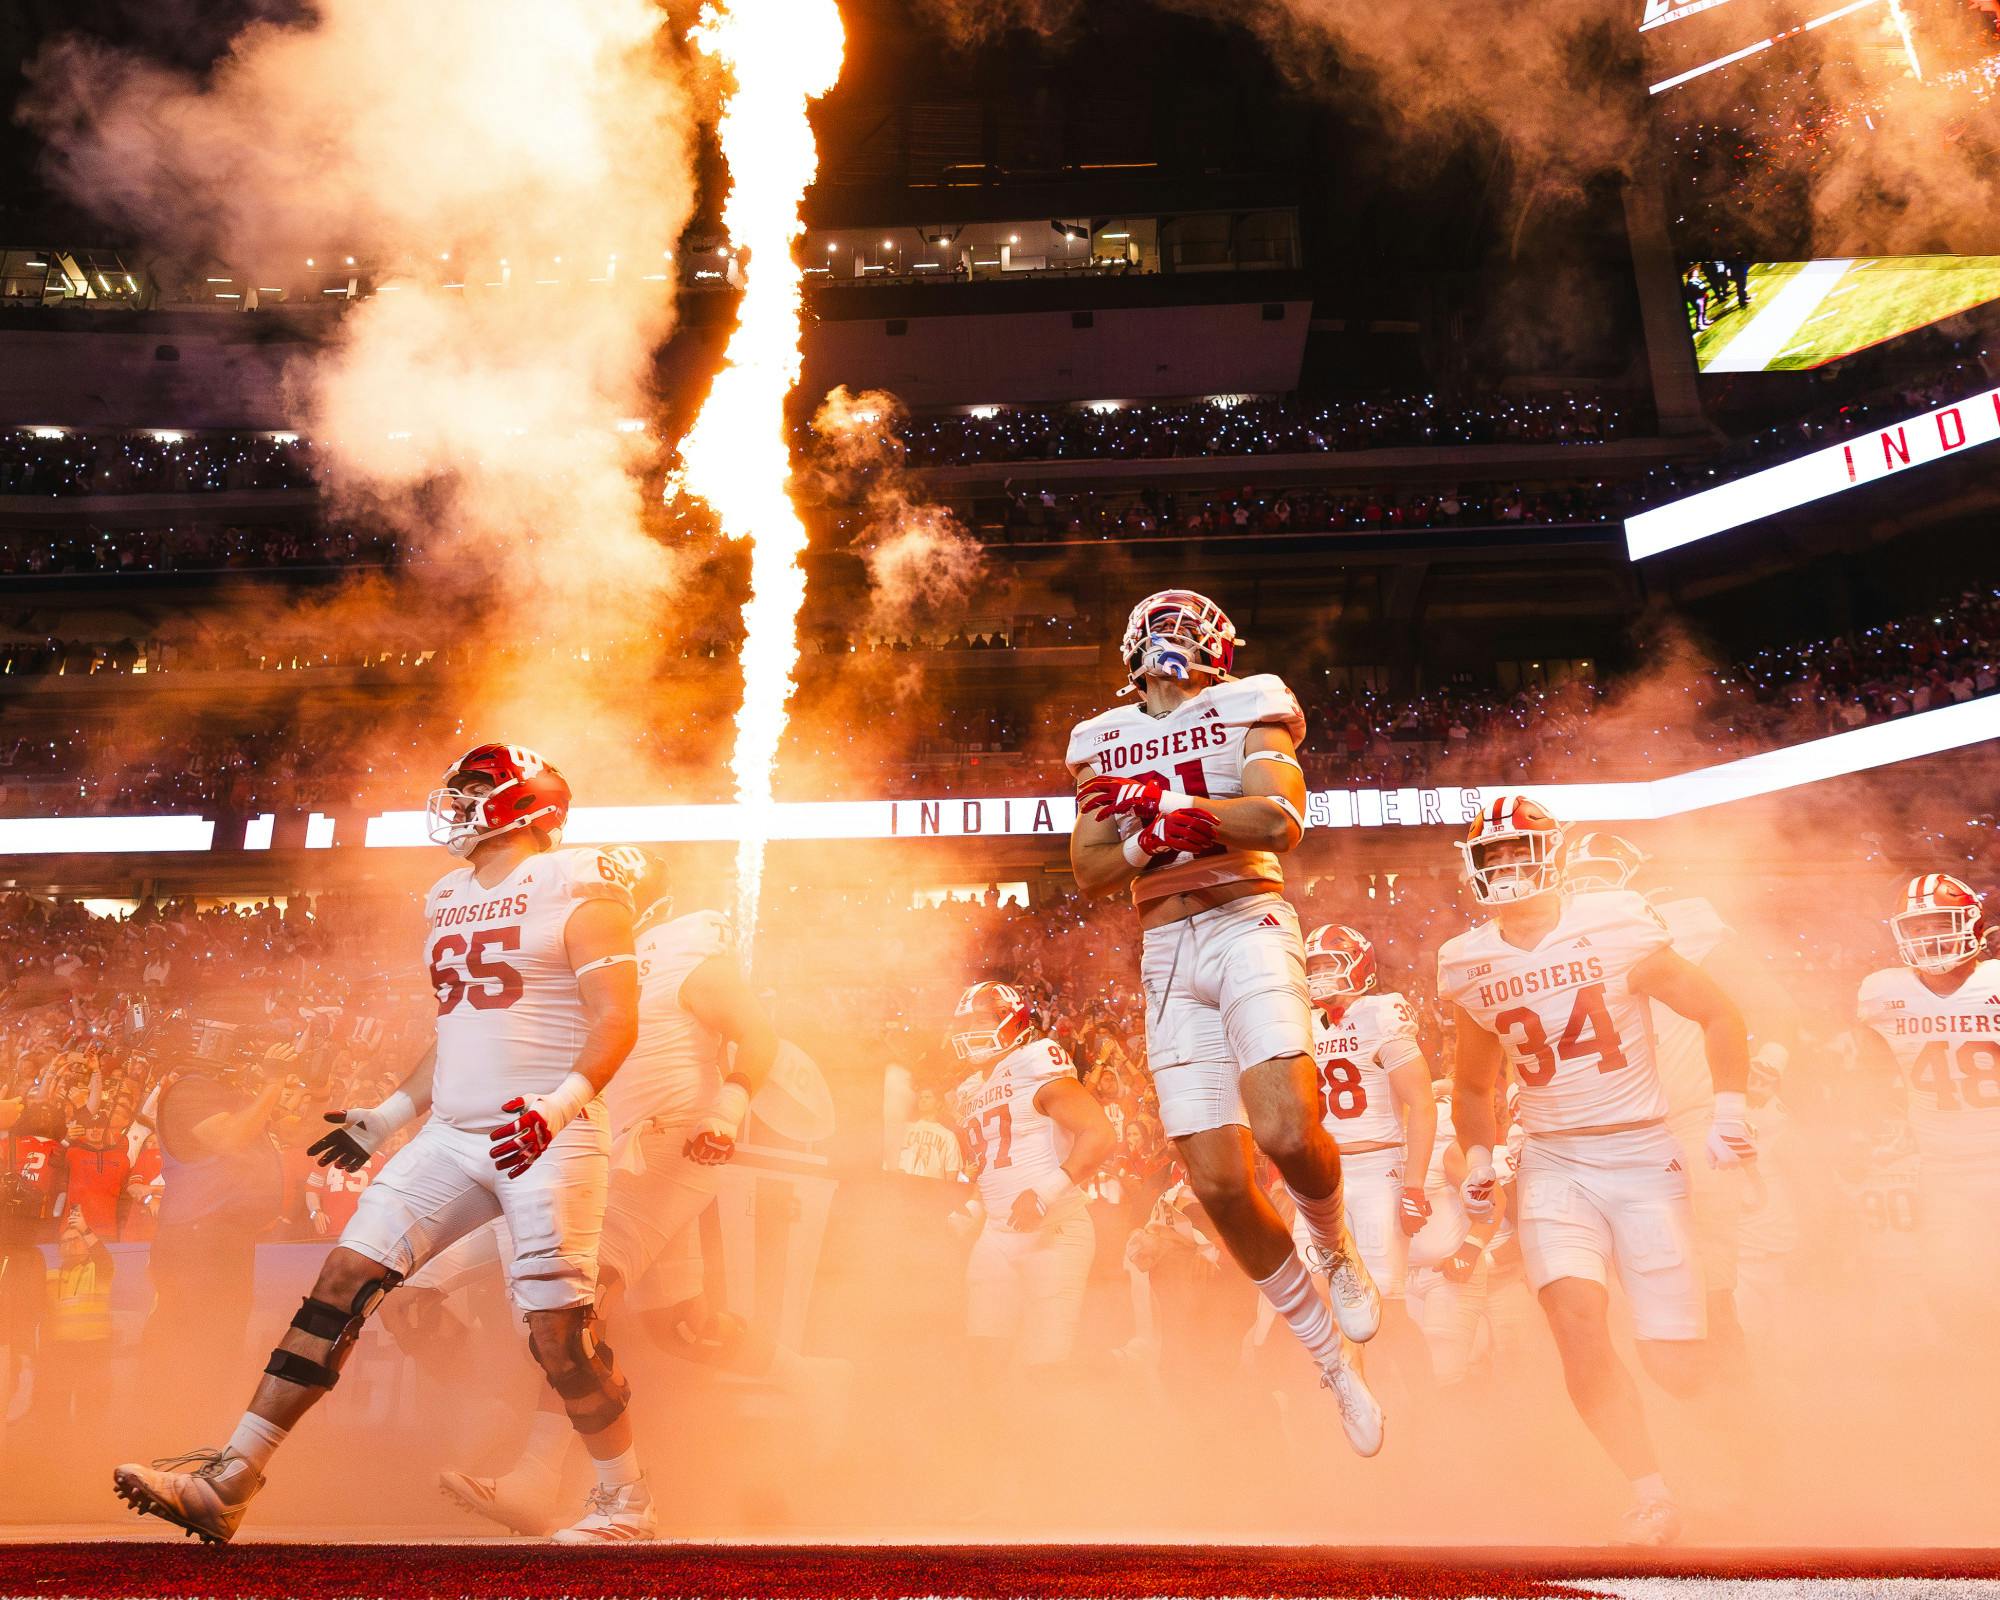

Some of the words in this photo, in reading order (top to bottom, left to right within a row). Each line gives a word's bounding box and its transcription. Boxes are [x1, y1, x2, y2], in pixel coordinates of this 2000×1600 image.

[1099, 722, 1227, 774] HOOSIERS
[891, 799, 1079, 835] INDIA
[435, 893, 528, 928] HOOSIERS
[430, 926, 523, 1017] 65
[1479, 957, 1604, 1008] HOOSIERS
[1495, 983, 1628, 1086] 34
[1911, 1040, 2000, 1111] 48
[964, 1103, 1013, 1178] 97
